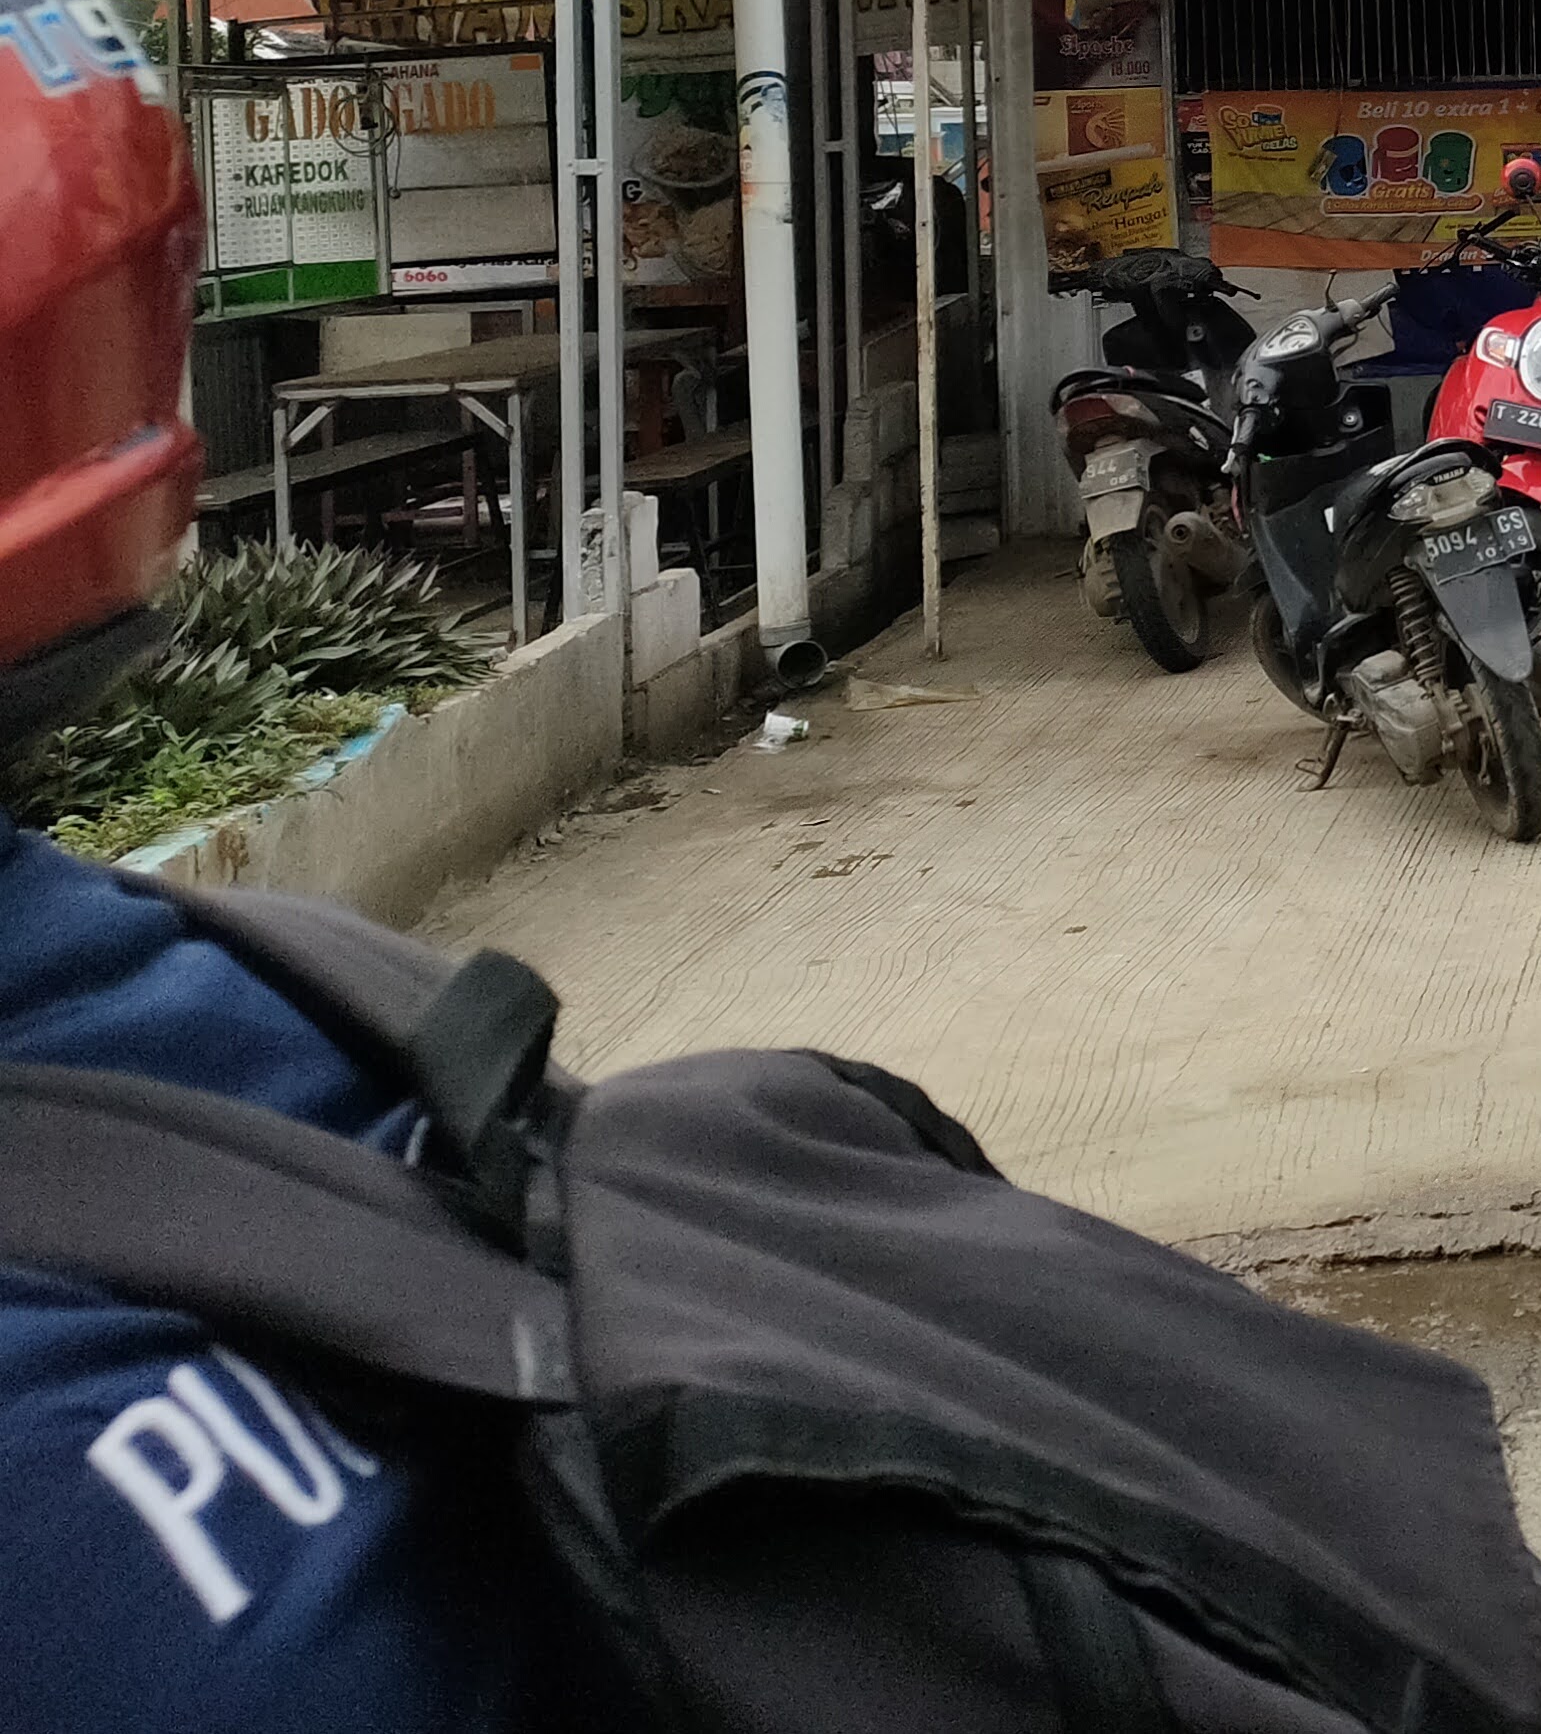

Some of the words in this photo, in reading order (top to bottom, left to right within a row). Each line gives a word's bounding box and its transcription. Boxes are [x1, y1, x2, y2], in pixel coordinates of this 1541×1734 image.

[1356, 100, 1400, 121] Beli
[1402, 99, 1430, 120] 10
[1432, 97, 1493, 119] extra
[243, 158, 350, 188] KAREDOK
[1370, 180, 1435, 200] Gratis
[1495, 405, 1508, 420] T
[1432, 467, 1466, 484] YAMAHA
[1496, 511, 1525, 534] GS
[1476, 535, 1530, 562] 10-19
